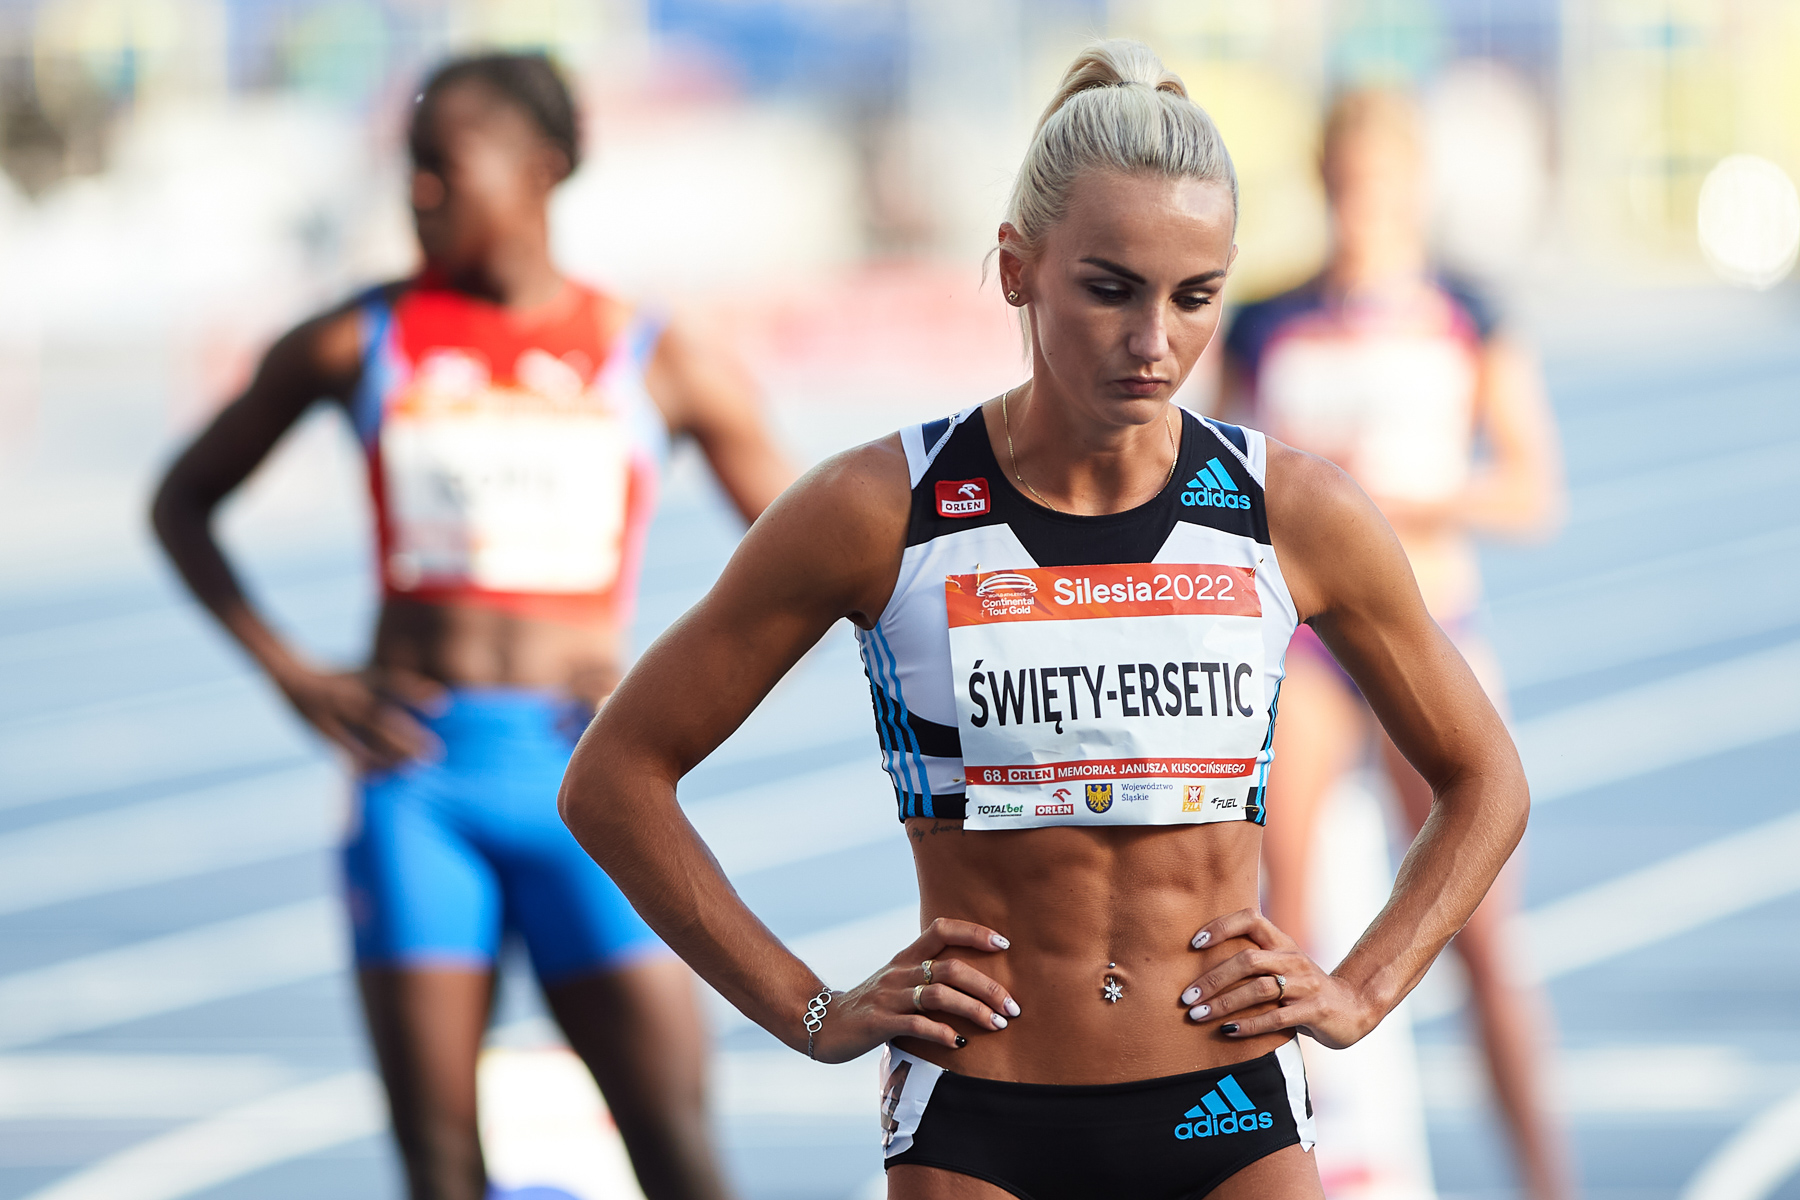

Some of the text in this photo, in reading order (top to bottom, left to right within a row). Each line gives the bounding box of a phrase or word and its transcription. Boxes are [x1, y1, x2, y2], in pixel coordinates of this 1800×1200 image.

[1180, 488, 1251, 510] adidas
[945, 500, 981, 513] ORLEN
[1053, 574, 1235, 605] Silesia2022
[982, 597, 1034, 608] Continental
[988, 605, 1031, 616] Tour Gold
[968, 659, 1254, 734] ŚWIĘTY-ERSETIC
[983, 761, 1246, 782] 68. ORLEN MEMORIAŁ JANUSZA KUSOCIŃSKIEGO
[1121, 782, 1173, 792] Województwo
[1121, 793, 1149, 802] Śląskie
[1037, 805, 1072, 814] ORLEN
[1174, 1111, 1274, 1140] adidas
